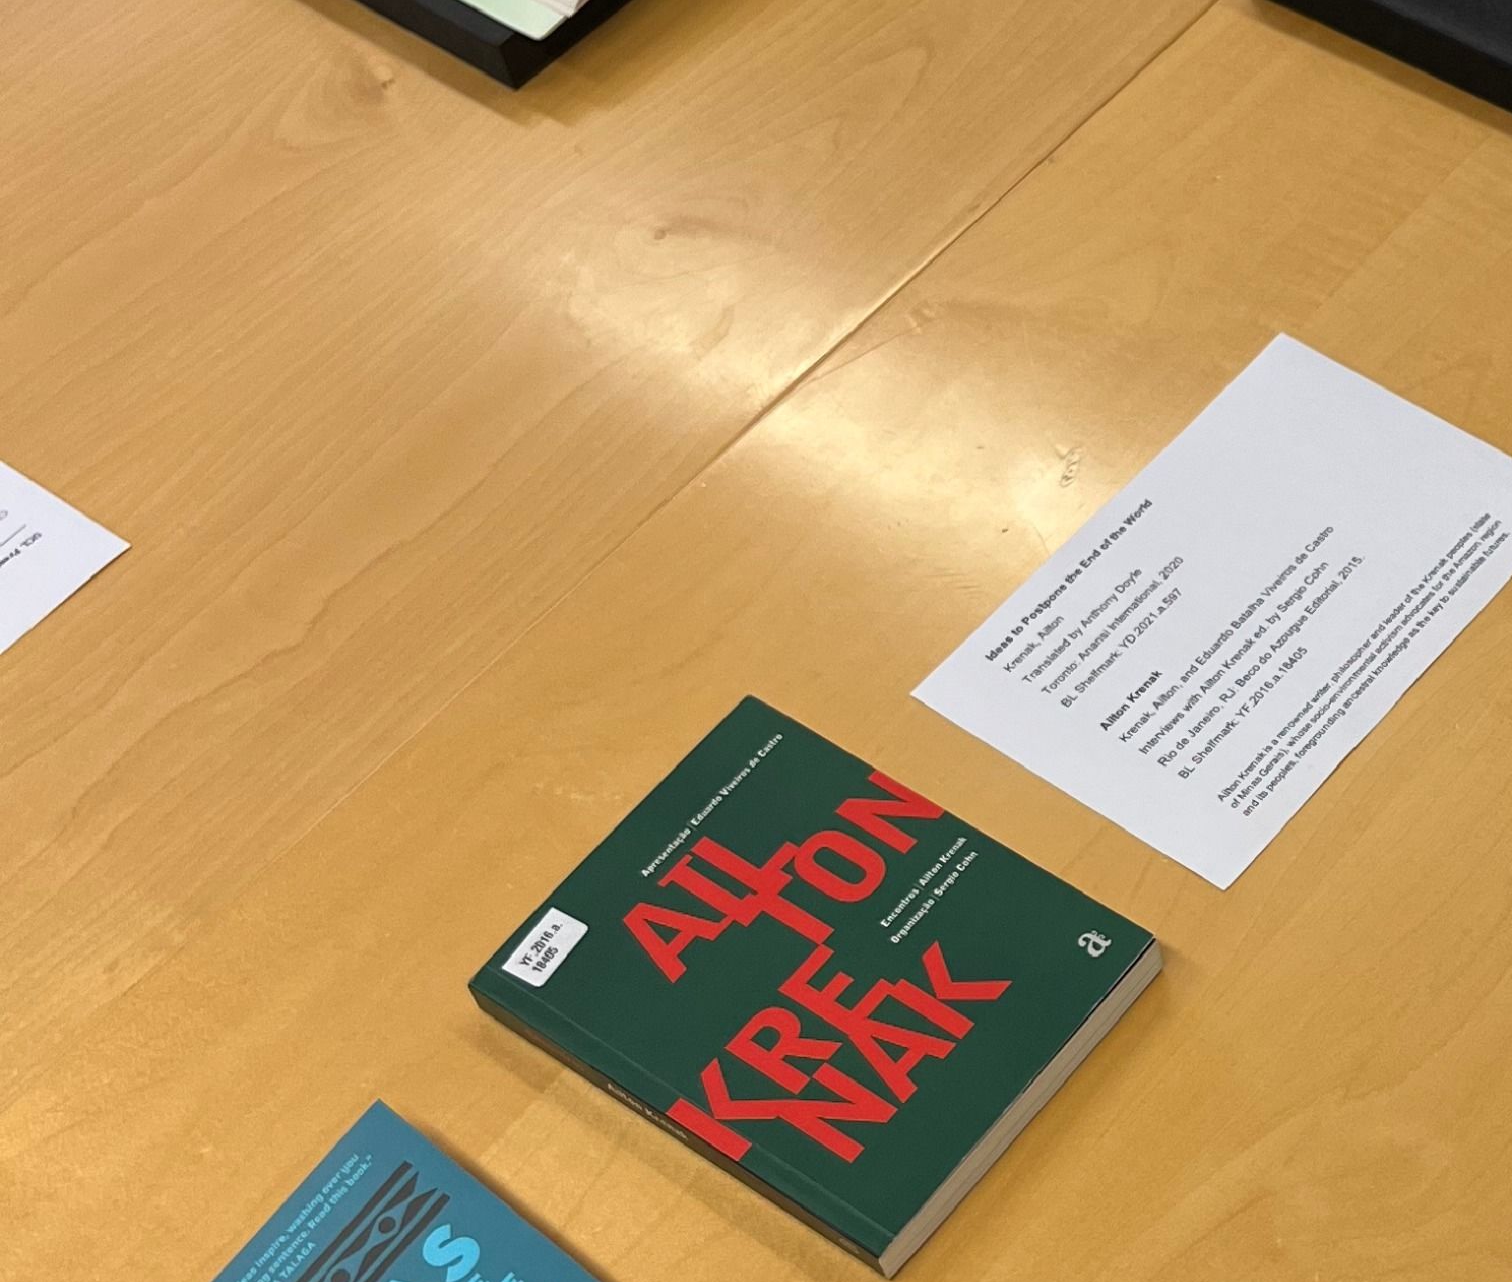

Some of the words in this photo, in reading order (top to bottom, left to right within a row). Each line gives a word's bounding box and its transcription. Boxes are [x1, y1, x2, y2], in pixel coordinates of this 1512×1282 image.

[984, 635, 1014, 662] Ideas
[1010, 625, 1024, 636] to
[1020, 584, 1068, 626] Postpone
[1064, 568, 1083, 585] the
[1079, 548, 1102, 569] End
[1099, 538, 1113, 551] of
[1109, 526, 1127, 541] the
[1122, 498, 1153, 526] World
[1021, 637, 1072, 683] Translated
[1067, 627, 1084, 640] by
[1080, 593, 1119, 629] Anthony
[1114, 568, 1142, 594] Doyle
[1040, 659, 1082, 694] Toronto:
[1077, 629, 1111, 662] Anansi
[1106, 579, 1163, 631] International,
[1158, 556, 1184, 581] 2020
[1118, 711, 1156, 743] Krenak,
[1152, 684, 1183, 711] Ailton,
[1180, 663, 1199, 684] and
[1194, 629, 1234, 666] Eduardo
[1230, 597, 1265, 630] Batalha
[1260, 564, 1298, 597] Viveiros
[1294, 552, 1309, 565] de
[1304, 526, 1334, 553] Castro
[1002, 642, 1042, 673] Krenak,
[1037, 615, 1065, 641] Ailton
[1060, 694, 1079, 709] BL
[1074, 647, 1124, 694] Shelfmark:
[1118, 587, 1182, 649] YD.2021.a.597
[1099, 703, 1131, 732] Ailton
[1126, 670, 1163, 703] Krenak
[1138, 712, 1185, 755] Interviews
[1182, 693, 1203, 712] with
[1199, 669, 1226, 695] Ailton
[1221, 637, 1256, 670] Krenak
[1253, 624, 1270, 639] ed.
[1264, 612, 1282, 625] by
[1276, 585, 1308, 613] Sergio
[1303, 562, 1329, 586] Cohn
[1156, 750, 1178, 767] Rio
[1175, 737, 1190, 751] de
[1187, 705, 1224, 738] Janeiro,
[1218, 686, 1240, 703] RJ:
[1234, 664, 1261, 688] Beco
[1258, 652, 1273, 665] do
[1269, 614, 1309, 653] Azougue
[1303, 579, 1343, 615] Editorial,
[1337, 556, 1366, 581] 2015.
[1177, 766, 1196, 780] BL
[1191, 716, 1242, 765] Shelfmark:
[1234, 646, 1308, 718] YF.2016.a.18405
[641, 828, 691, 877] Apresentação
[690, 795, 723, 826] Eduardo
[718, 767, 751, 796] Viveiros
[749, 757, 760, 768] de
[757, 734, 783, 758] Castro
[880, 888, 920, 928] Encontros
[919, 863, 943, 887] Ailton
[938, 837, 967, 863] Krenak
[890, 898, 935, 944] Organização
[933, 871, 959, 897] Sergio
[955, 851, 979, 872] Cohn
[531, 946, 559, 973] 18405
[278, 1242, 316, 1279] TALAGA
